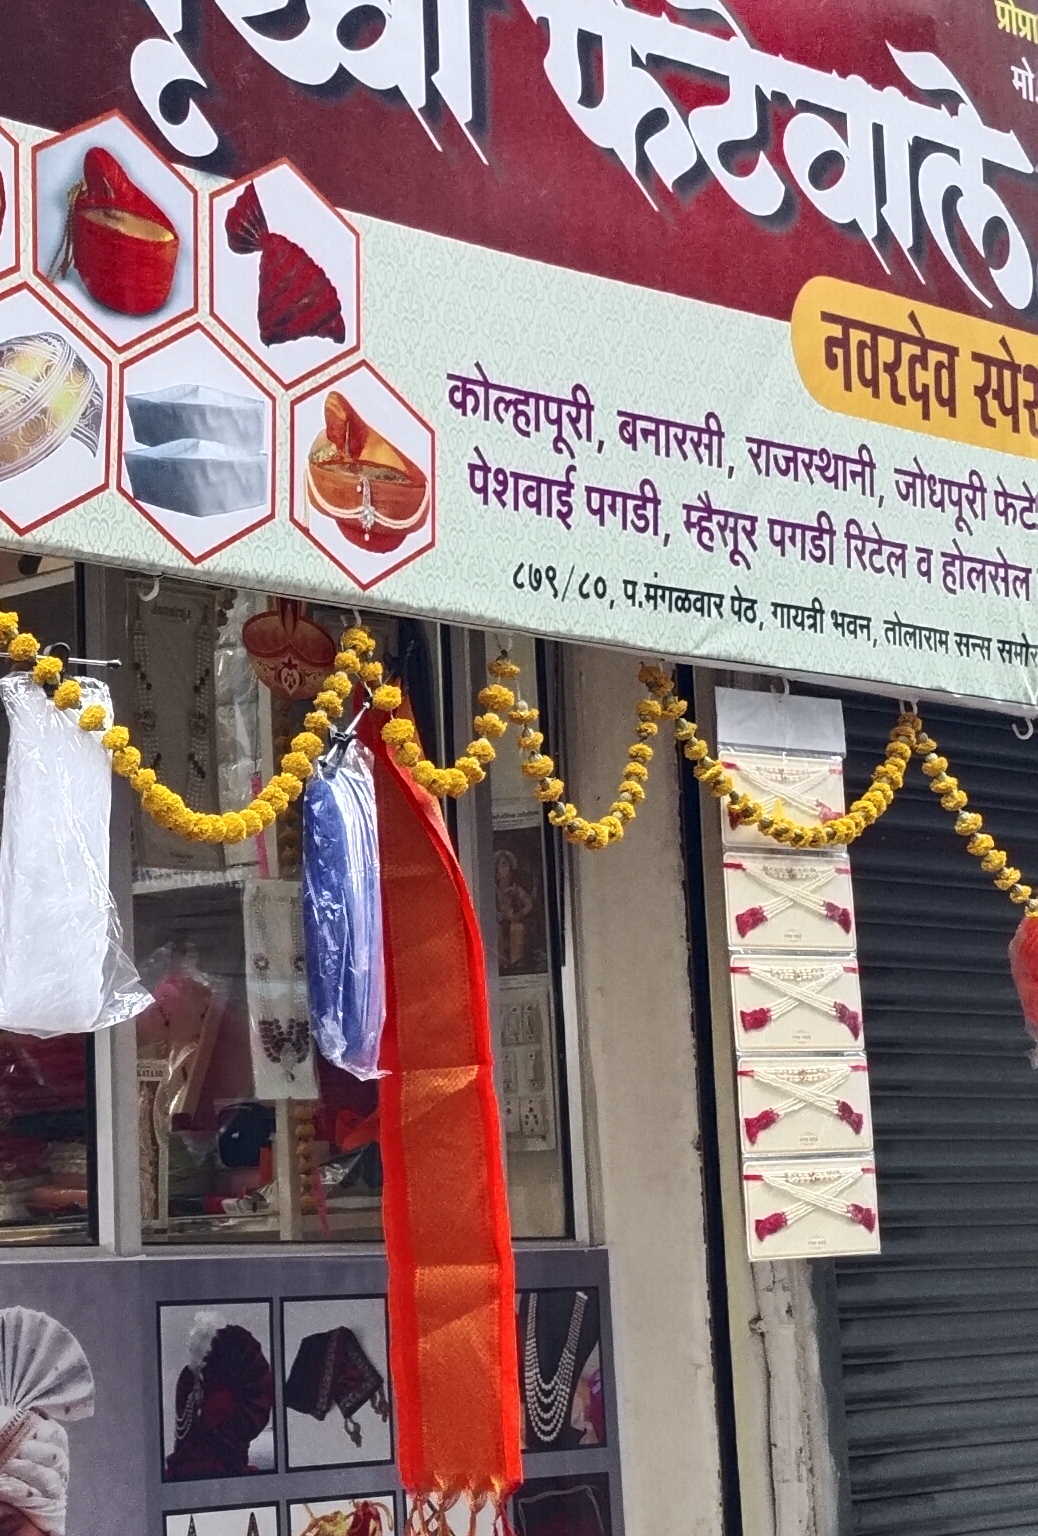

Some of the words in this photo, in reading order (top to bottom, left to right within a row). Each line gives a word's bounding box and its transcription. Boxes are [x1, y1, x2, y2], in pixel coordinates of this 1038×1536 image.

[819, 309, 960, 422] नवरदेव
[446, 362, 606, 459] कोल्हापूरी,
[616, 410, 736, 479] बनारसी,
[745, 434, 885, 508] राजस्थानी,
[893, 456, 988, 537] जोधपूरी
[467, 445, 577, 531] पेशवाई
[585, 478, 671, 547] पगडी,
[682, 490, 759, 570] म्हैसूर
[768, 511, 836, 566] पगडी
[844, 517, 908, 580] रिटेल
[915, 546, 934, 584] व
[940, 538, 1033, 602] होलसेल
[730, 584, 765, 632] पेठ,
[770, 596, 825, 636] गायत्री
[830, 610, 878, 648] भवन,
[882, 610, 950, 655] तोलाराम
[954, 632, 993, 661] सन्स
